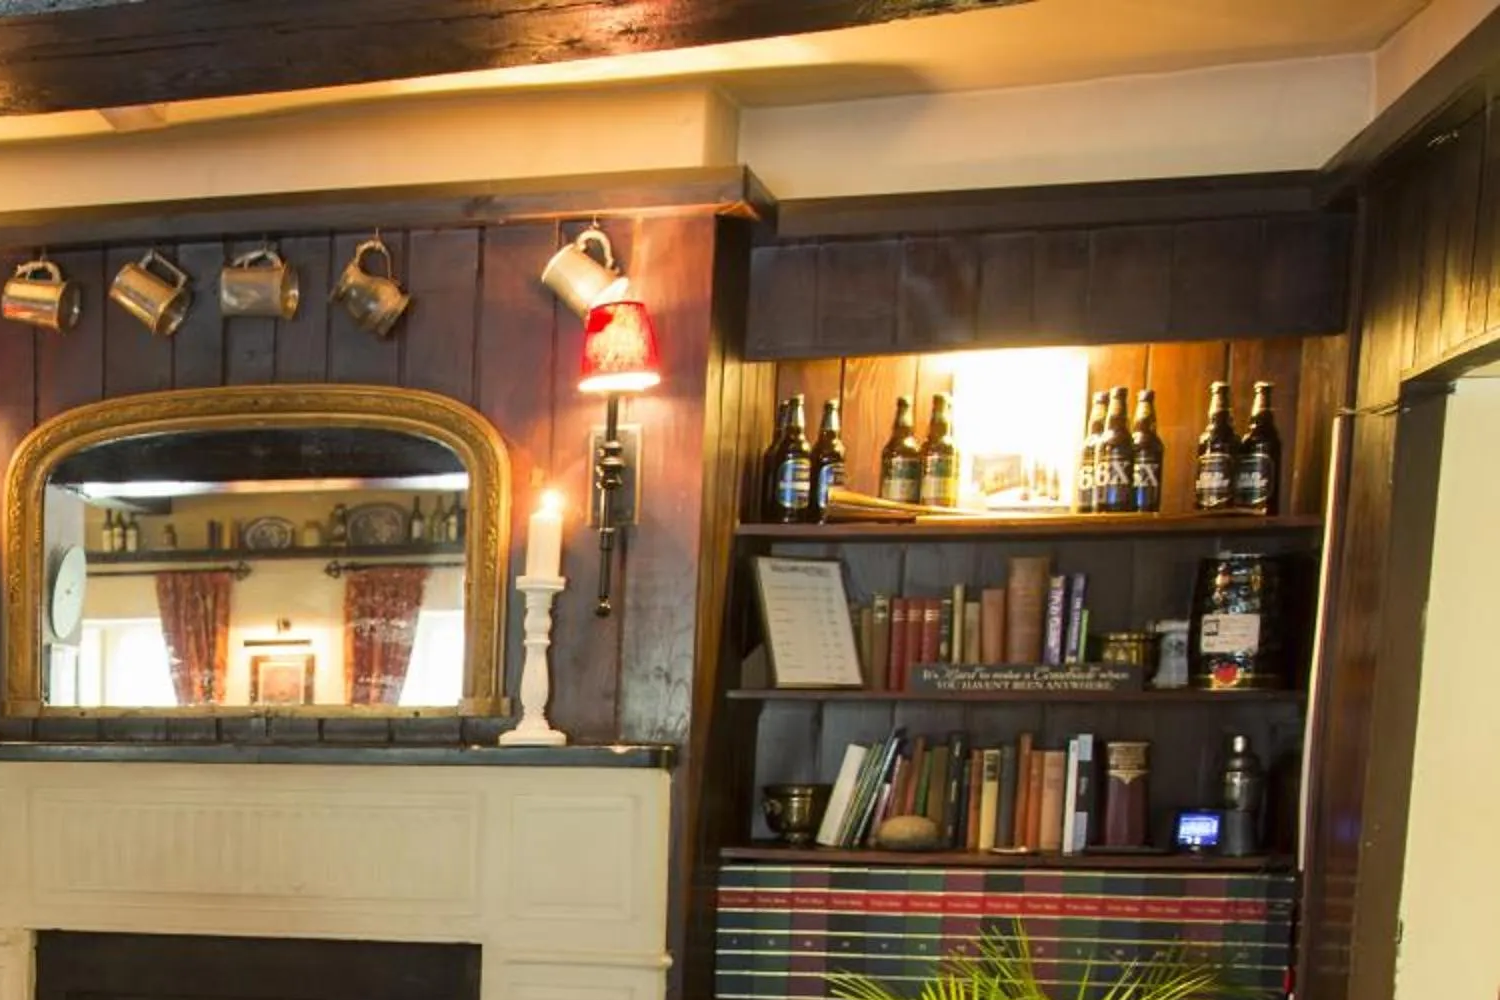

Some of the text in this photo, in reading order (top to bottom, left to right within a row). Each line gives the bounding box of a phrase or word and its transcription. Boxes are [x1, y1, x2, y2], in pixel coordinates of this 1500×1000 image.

[1095, 461, 1129, 486] 6X
[923, 669, 939, 681] It's
[992, 670, 1021, 681] make
[1099, 669, 1129, 681] when
[936, 681, 955, 691] YOU
[1011, 681, 1044, 691] BEEN
